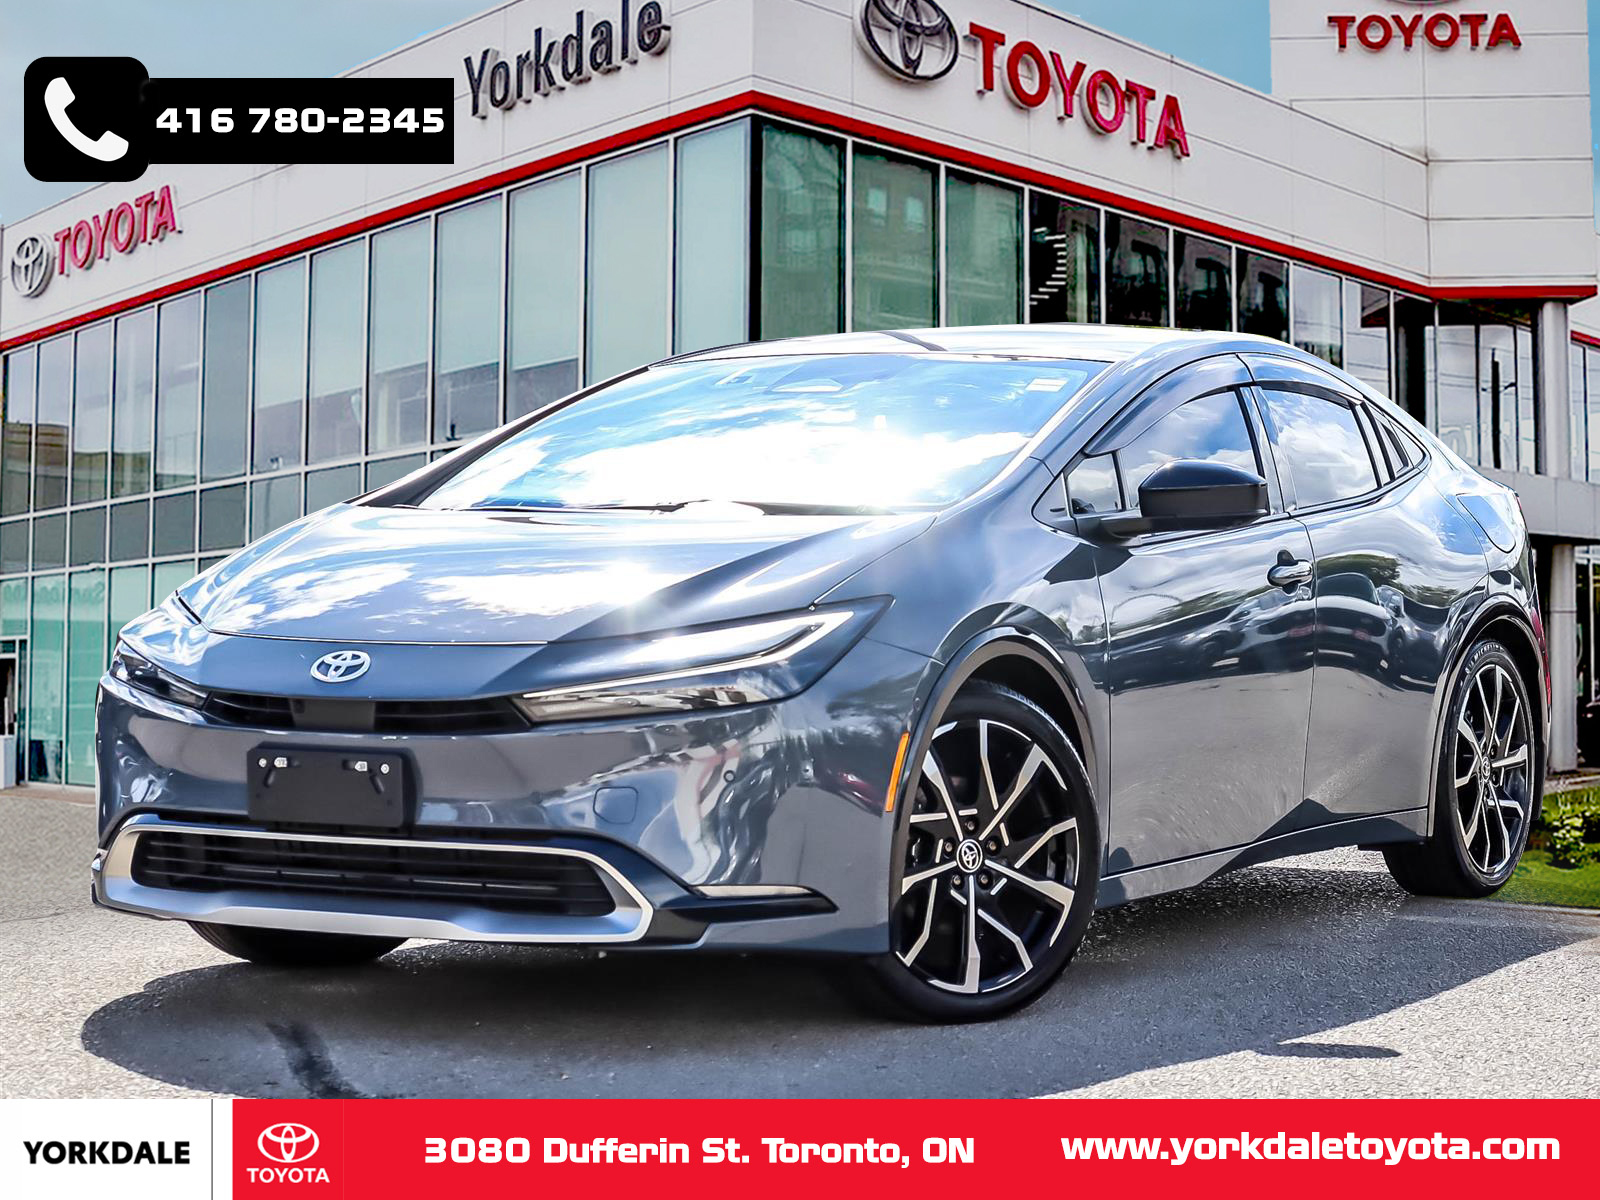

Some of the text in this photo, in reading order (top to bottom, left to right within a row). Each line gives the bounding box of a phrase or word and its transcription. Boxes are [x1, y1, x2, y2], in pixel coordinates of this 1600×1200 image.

[463, 0, 671, 118] Yorkdale
[1327, 12, 1522, 50] TOYOTA
[967, 21, 1190, 159] TOYOTA
[54, 184, 179, 276] TOYOTA
